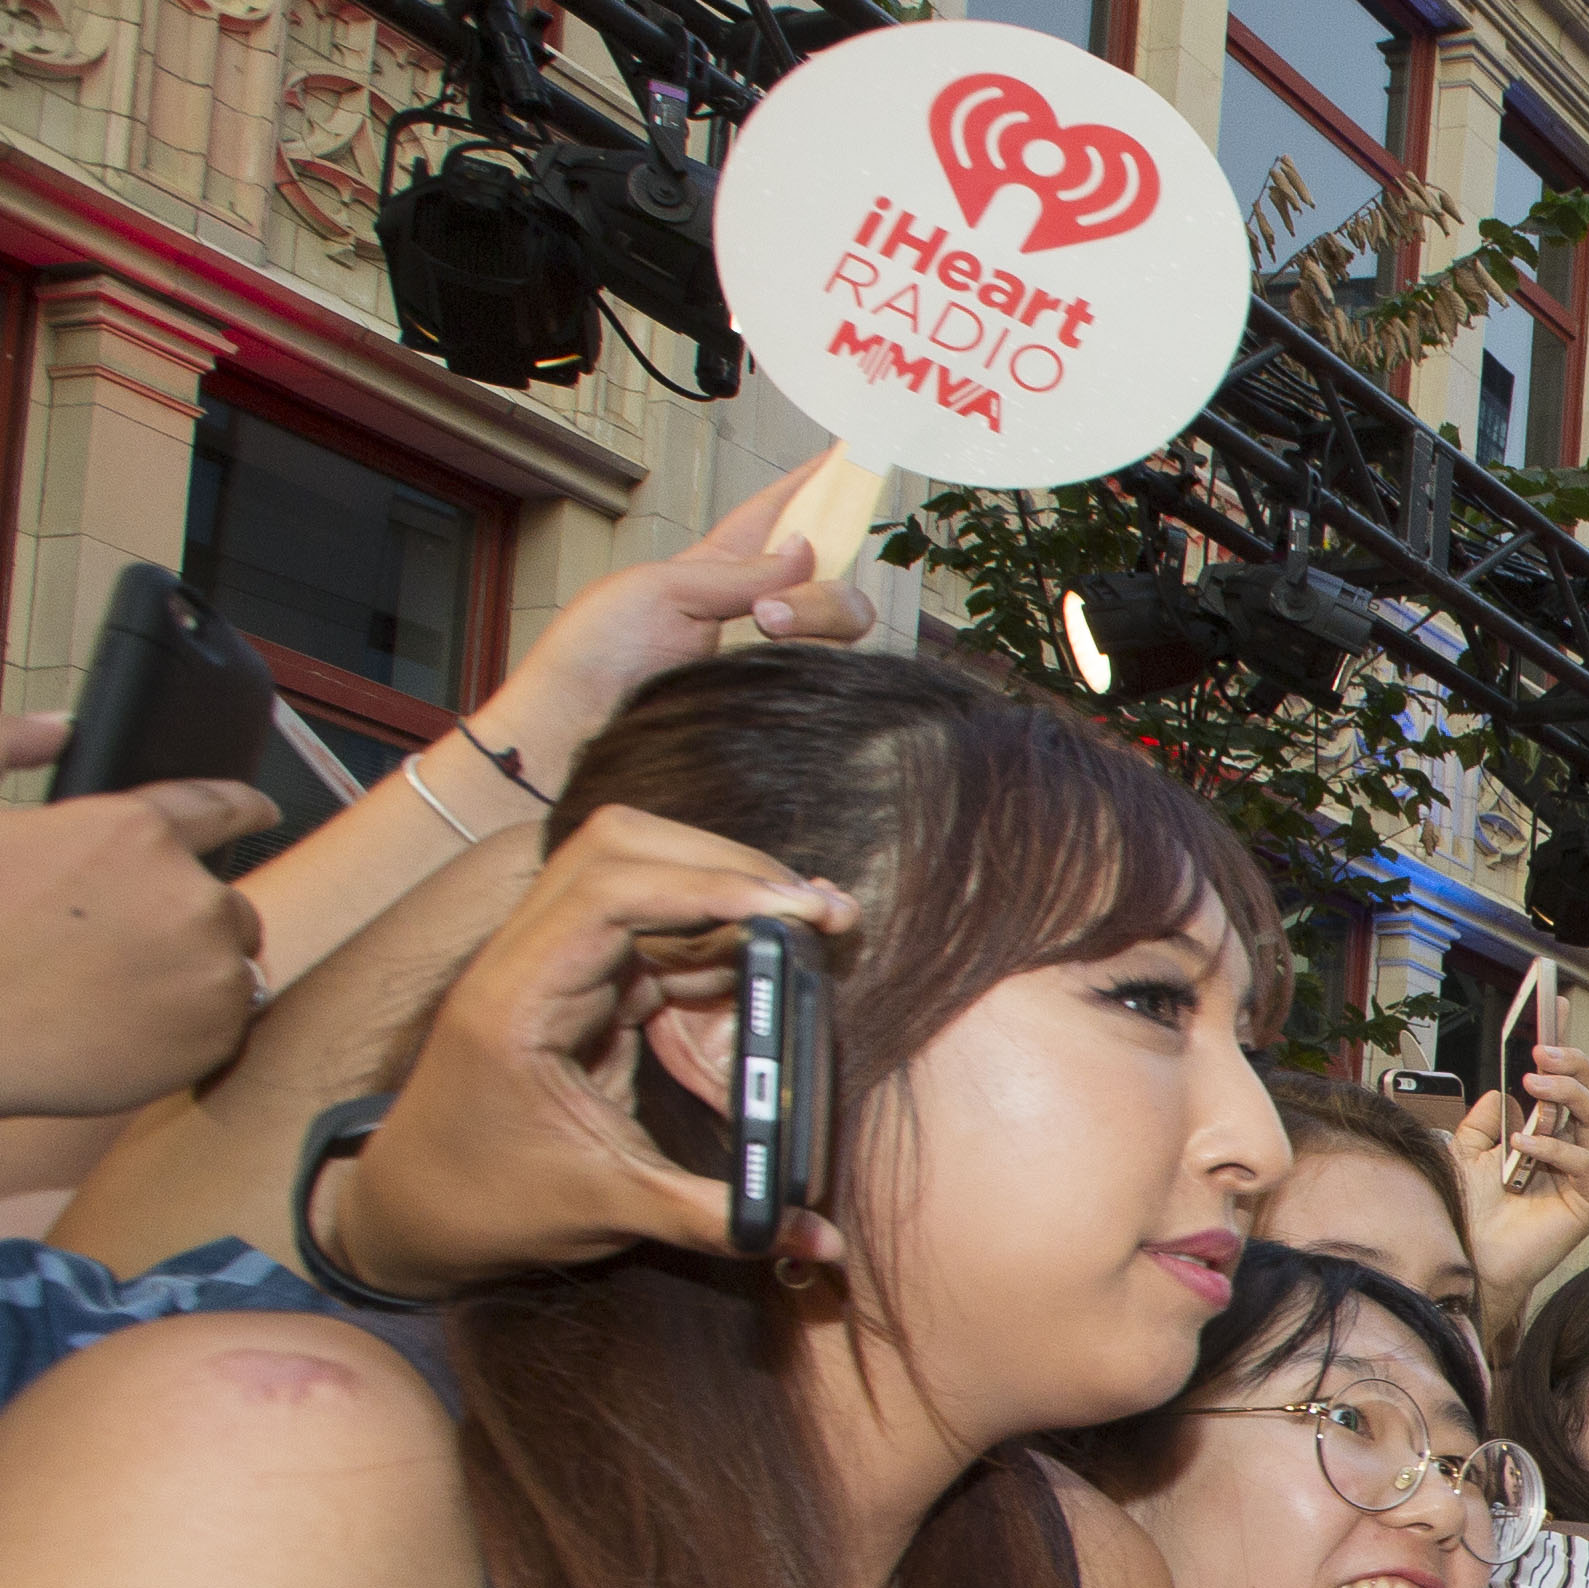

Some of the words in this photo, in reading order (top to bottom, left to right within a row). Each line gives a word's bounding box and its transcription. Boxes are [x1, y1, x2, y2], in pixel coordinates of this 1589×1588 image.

[824, 251, 1064, 392] RADIO
[853, 196, 1095, 349] iHeart
[827, 319, 1002, 434] MMVA
